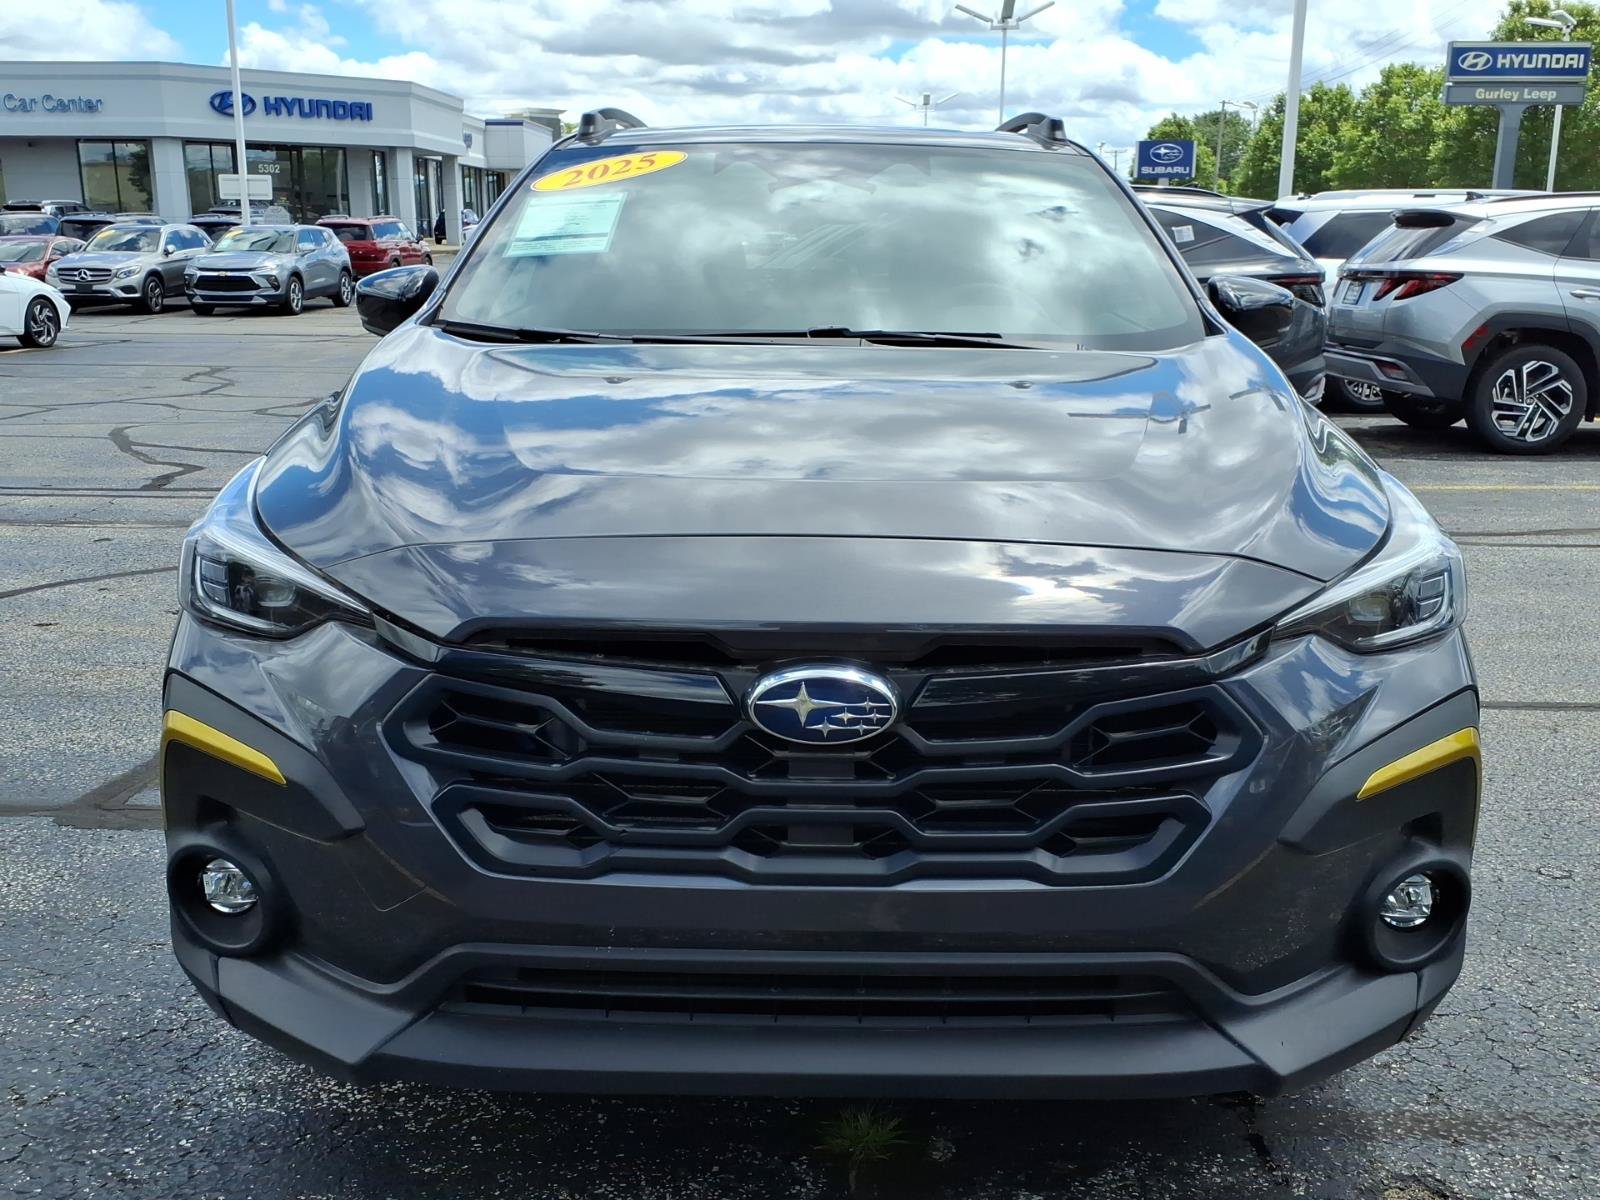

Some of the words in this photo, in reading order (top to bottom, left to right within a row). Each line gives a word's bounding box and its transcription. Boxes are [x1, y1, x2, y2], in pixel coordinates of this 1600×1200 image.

[1496, 53, 1585, 69] HYUNDAI
[1474, 88, 1519, 101] Gurley
[1523, 88, 1557, 101] Leep
[3, 93, 38, 112] Car
[41, 94, 103, 113] Center
[263, 96, 374, 121] HYUNDAI
[258, 164, 281, 174] 5302
[562, 153, 657, 187] 2025
[1141, 166, 1190, 174] SUBARU
